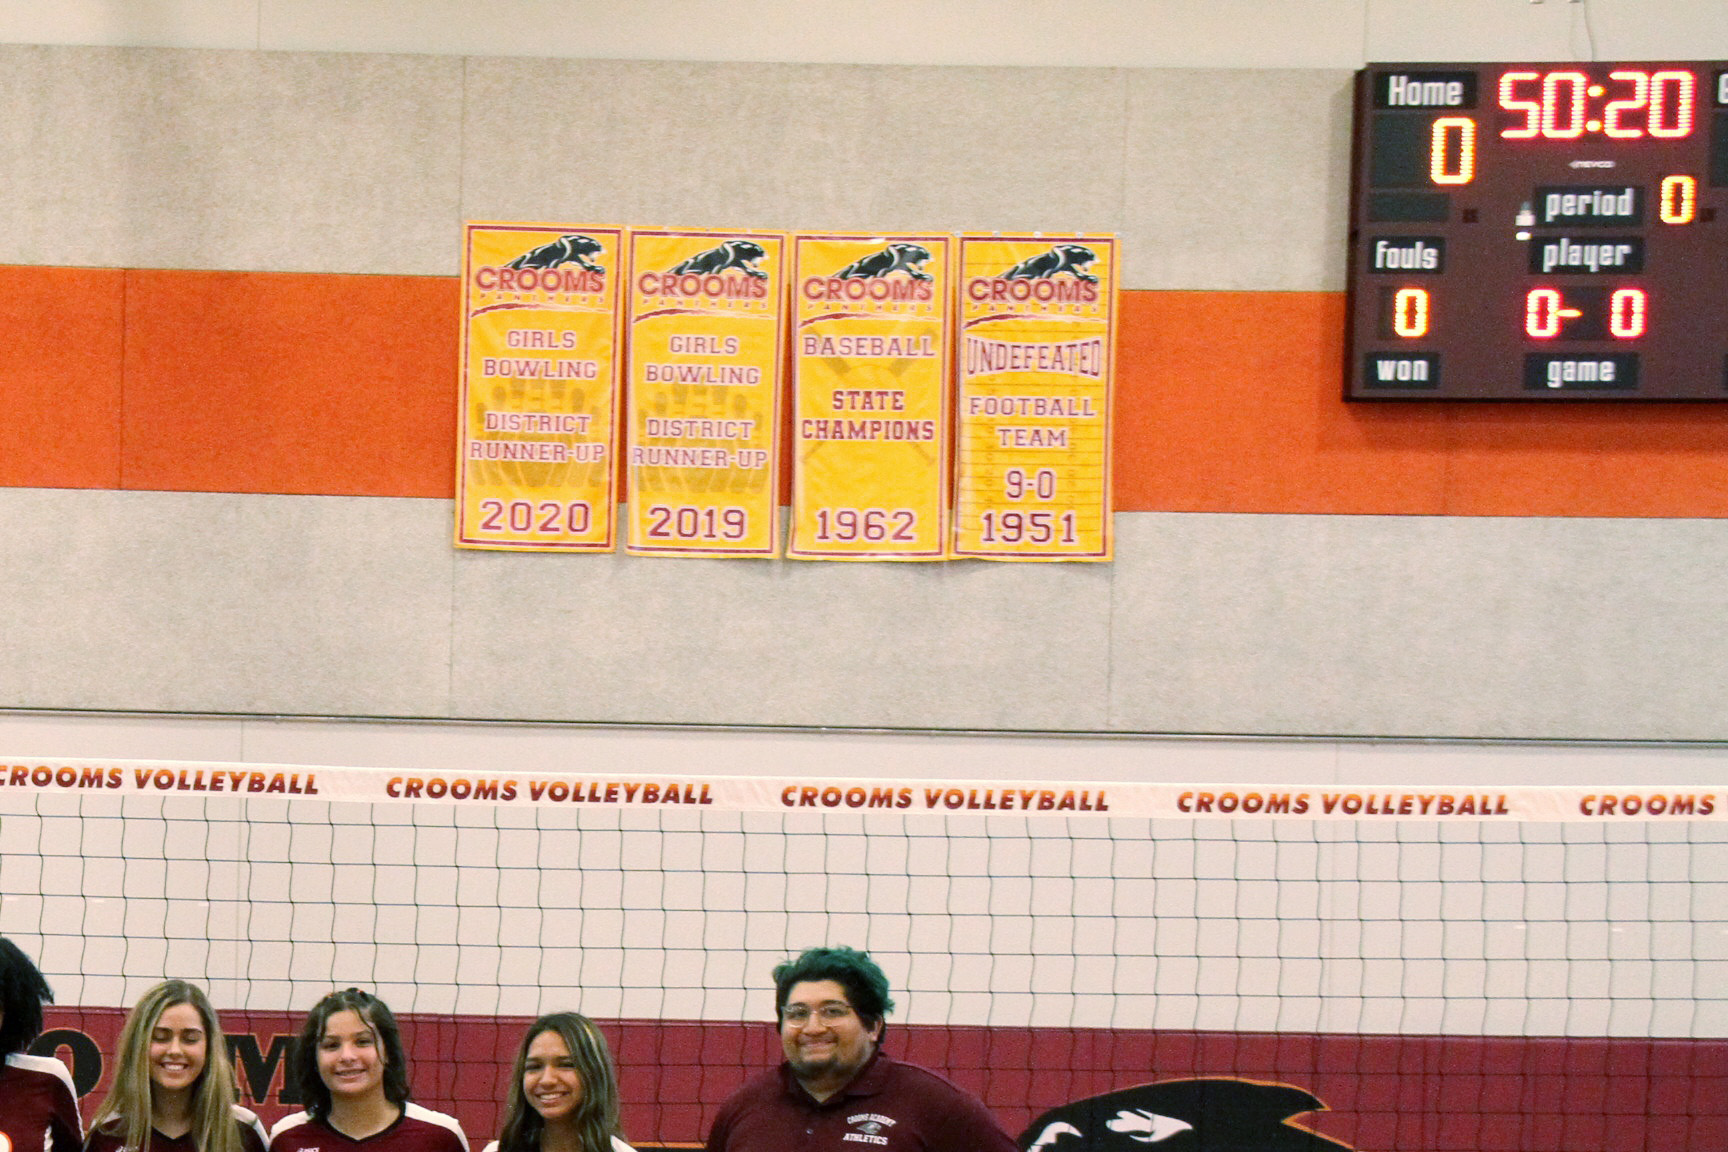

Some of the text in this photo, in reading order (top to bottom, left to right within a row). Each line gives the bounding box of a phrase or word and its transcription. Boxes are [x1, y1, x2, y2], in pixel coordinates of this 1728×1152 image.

[1388, 75, 1463, 106] Home
[1498, 71, 1695, 138] 50:20
[1430, 117, 1477, 185] 0
[1545, 188, 1634, 221] period
[1660, 175, 1697, 225] 0
[1375, 241, 1439, 269] fouls
[1542, 238, 1632, 272] player
[475, 267, 605, 292] CROOMS
[638, 272, 769, 299] CROOMS
[803, 277, 934, 301] CROOMS
[968, 278, 1099, 302] CROOMS
[1393, 288, 1430, 338] 0
[506, 329, 576, 350] GIRLS
[669, 334, 738, 355] GIRLS
[803, 334, 936, 358] BASEBALL
[483, 357, 597, 380] BOWLING
[967, 338, 1101, 378] UNDEFEATED
[1376, 359, 1429, 382] won
[645, 364, 760, 386] BOWLING
[1547, 359, 1616, 388] game
[832, 389, 905, 412] STATE
[969, 396, 1096, 418] FOOTBALL
[484, 413, 590, 435] DISTRICT
[646, 418, 753, 440] DISTRICT
[802, 418, 935, 442] CHAMPIONS
[999, 427, 1068, 449] TEAM
[470, 441, 605, 464] RUNNER-UP
[633, 446, 768, 469] RUNNER-UP
[1005, 470, 1056, 500] 9-0
[480, 500, 590, 534] 2020
[648, 506, 747, 541] 2019
[817, 509, 916, 542] 1962
[980, 511, 1076, 544] 1951
[133, 768, 319, 794] VOLLEYBALL
[386, 776, 714, 804] CROOMS VOLLEYBALL
[781, 785, 1110, 811] CROOMS VOLLEYBALL
[1177, 791, 1509, 815] CROOMS VOLLEYBALL
[1579, 794, 1716, 815] CROOMS
[843, 1133, 888, 1145] ATHLETICS
